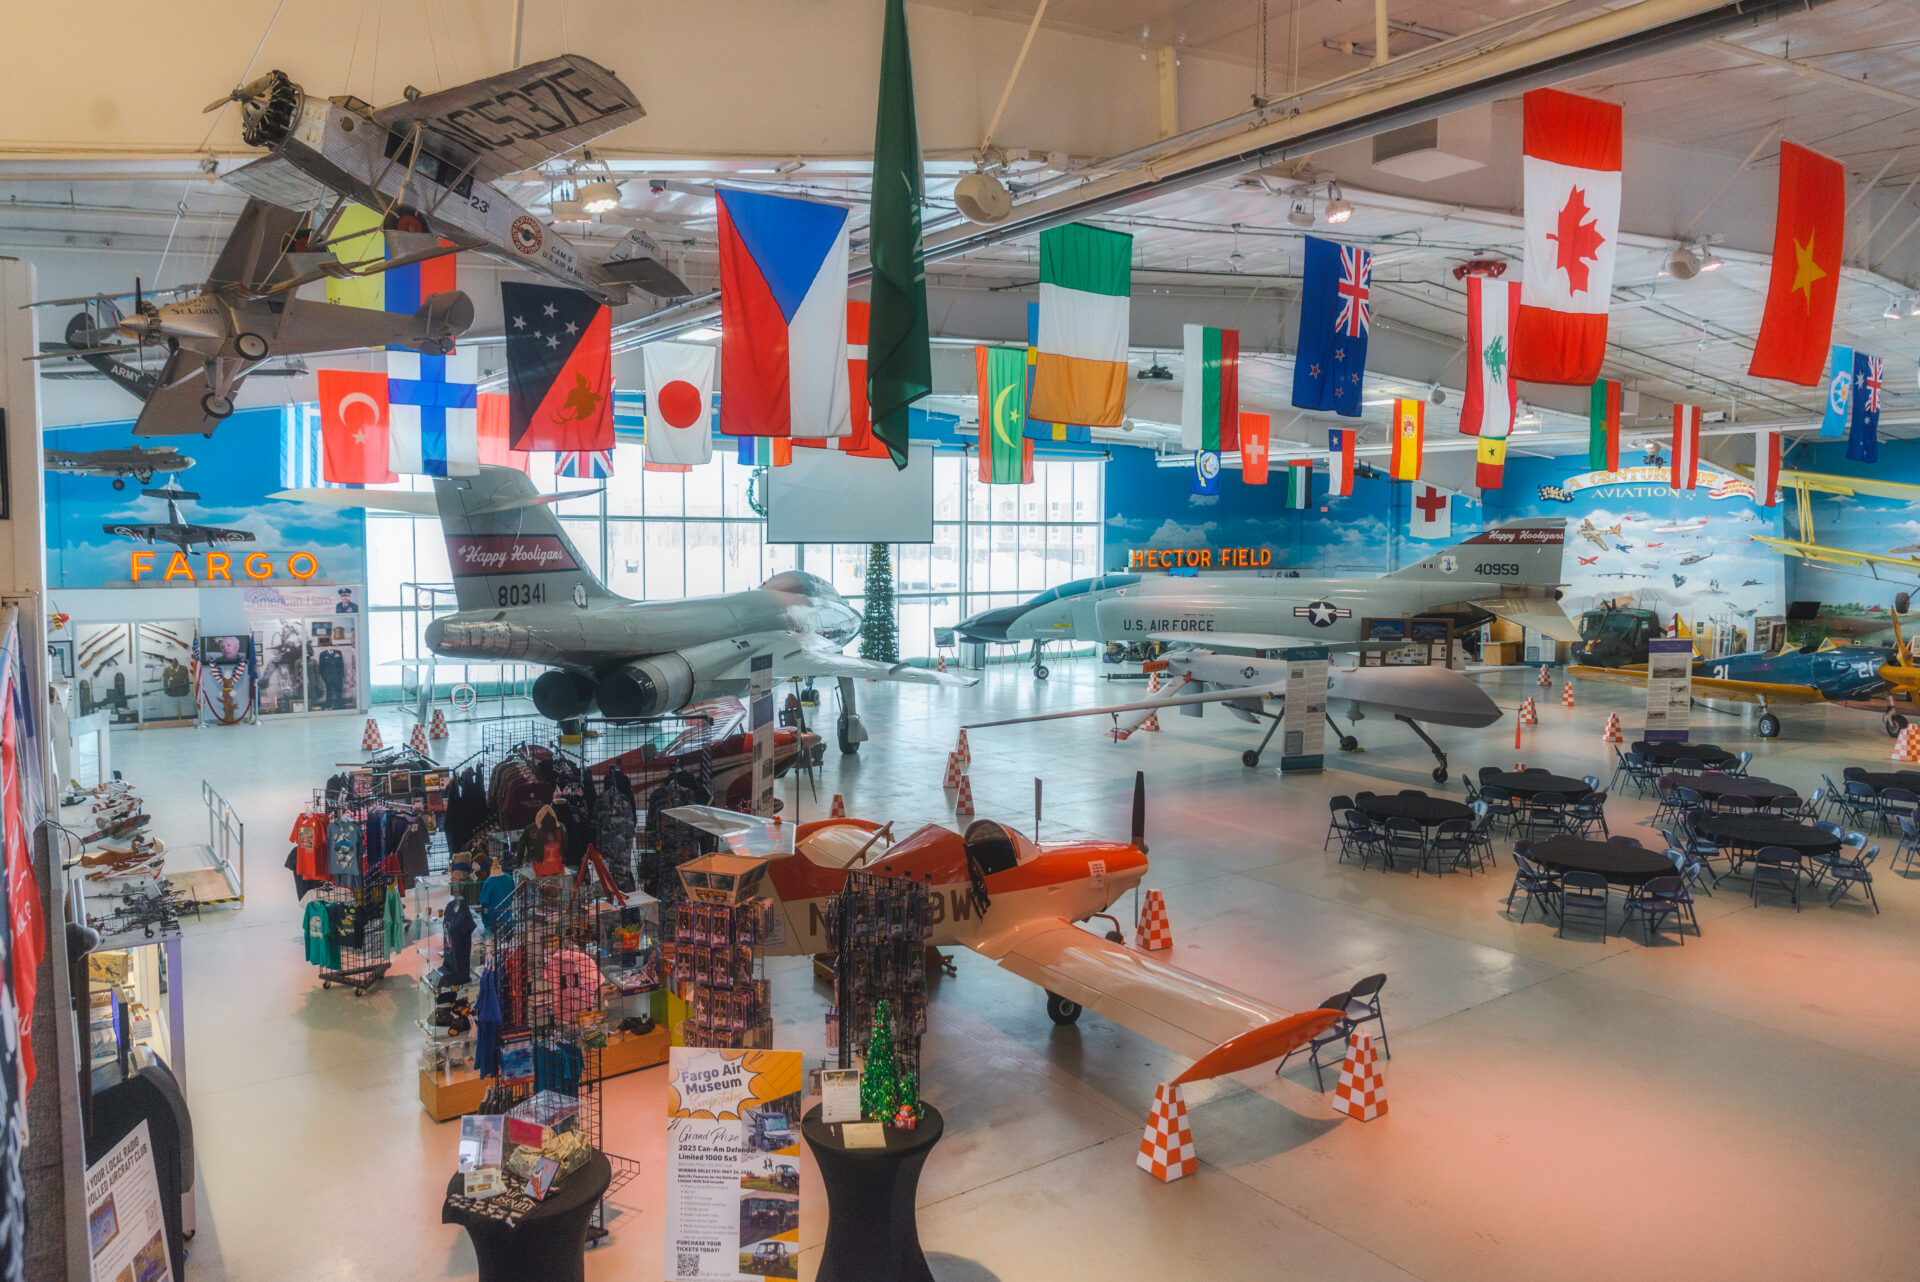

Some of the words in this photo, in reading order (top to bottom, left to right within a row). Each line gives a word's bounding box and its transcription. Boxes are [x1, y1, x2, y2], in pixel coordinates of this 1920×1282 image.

[427, 67, 628, 153] NC537E
[471, 196, 489, 213] 23
[552, 246, 566, 259] CAM
[555, 258, 566, 269] AIR
[567, 265, 583, 280] MAIL
[110, 364, 140, 382] ARMY
[1568, 477, 1582, 491] A
[1592, 486, 1680, 499] AVIATION
[1488, 530, 1516, 544] Happy
[1519, 530, 1565, 543] Hooligans
[465, 545, 508, 568] Happy
[511, 544, 564, 566] Hooligans
[1131, 548, 1212, 568] HECTOR
[1221, 548, 1272, 567] FIELD
[130, 551, 319, 581] FARGO
[1474, 563, 1520, 576] 40959
[498, 583, 546, 607] 80341
[1123, 619, 1147, 631] U.S.
[1150, 619, 1170, 631] AIR
[1172, 619, 1215, 632] FORCE
[1713, 664, 1729, 680] 21
[1858, 660, 1876, 679] 21
[681, 1068, 719, 1083] Fargo
[722, 1062, 742, 1076] Air
[685, 1077, 742, 1096] Museum
[678, 1124, 709, 1144] Grand
[710, 1126, 740, 1144] Prize
[698, 1145, 725, 1153] Can-Am
[726, 1146, 757, 1154] Defender
[89, 1167, 105, 1187] YOUR
[105, 1151, 124, 1175] LOCAL
[122, 1135, 140, 1159] RADIO
[109, 1157, 136, 1187] AIRCRAFT
[134, 1143, 148, 1165] CLUB
